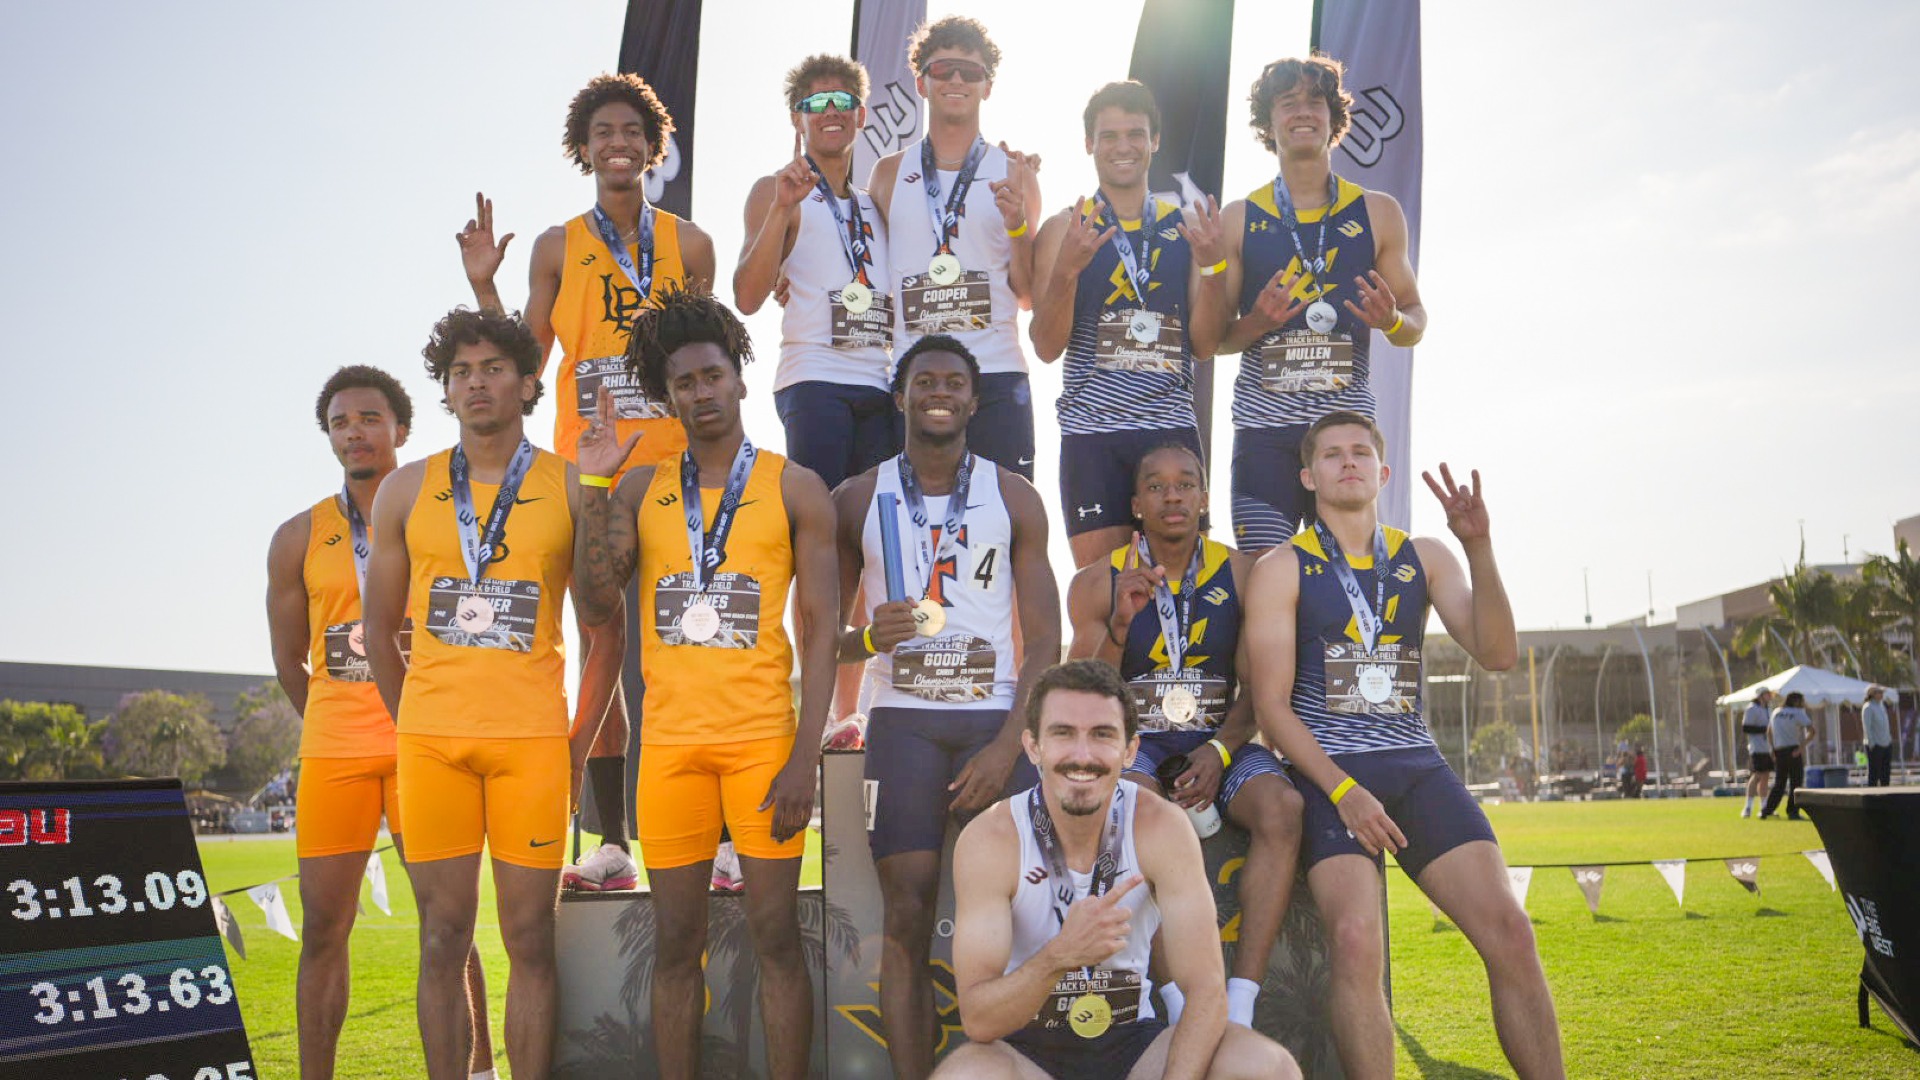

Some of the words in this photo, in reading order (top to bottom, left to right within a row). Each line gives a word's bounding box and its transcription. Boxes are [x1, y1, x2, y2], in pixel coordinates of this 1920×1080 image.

[923, 287, 968, 303] COOPER
[1285, 347, 1332, 361] MULLEN
[598, 364, 619, 372] TRACK
[974, 548, 997, 590] 4
[713, 573, 738, 581] WEST
[460, 583, 483, 592] TRAK
[491, 585, 511, 594] FIELD
[713, 582, 732, 590] FIELD
[682, 593, 729, 609] JONES
[923, 652, 969, 666] GOODE
[1352, 651, 1370, 659] TRAC
[1379, 652, 1397, 660] FIELD
[7, 870, 207, 920] 3:13.09
[30, 965, 233, 1025] 3:13.63
